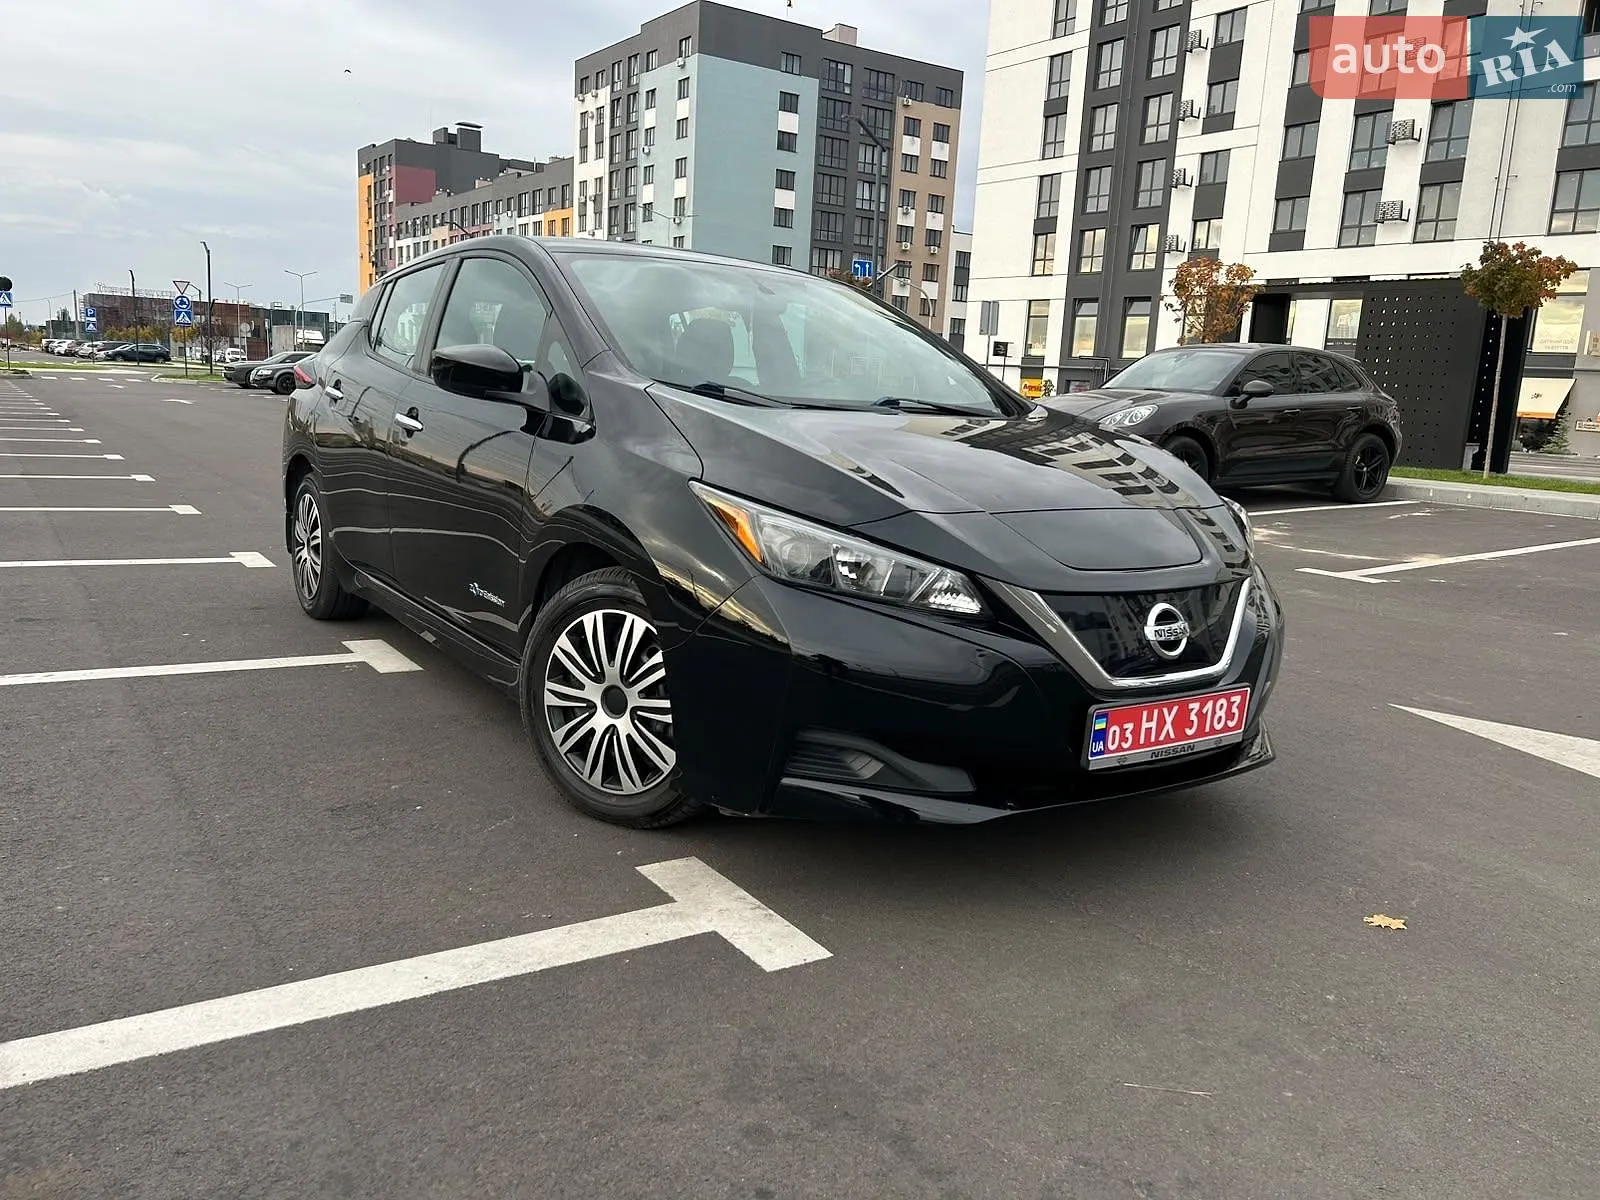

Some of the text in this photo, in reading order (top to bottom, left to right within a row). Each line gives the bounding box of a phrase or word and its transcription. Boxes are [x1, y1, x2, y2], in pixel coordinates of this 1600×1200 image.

[87, 308, 95, 317] P
[1107, 695, 1242, 751] 03 HX 3183
[1092, 740, 1104, 753] UA
[1150, 744, 1195, 759] NISSAN
